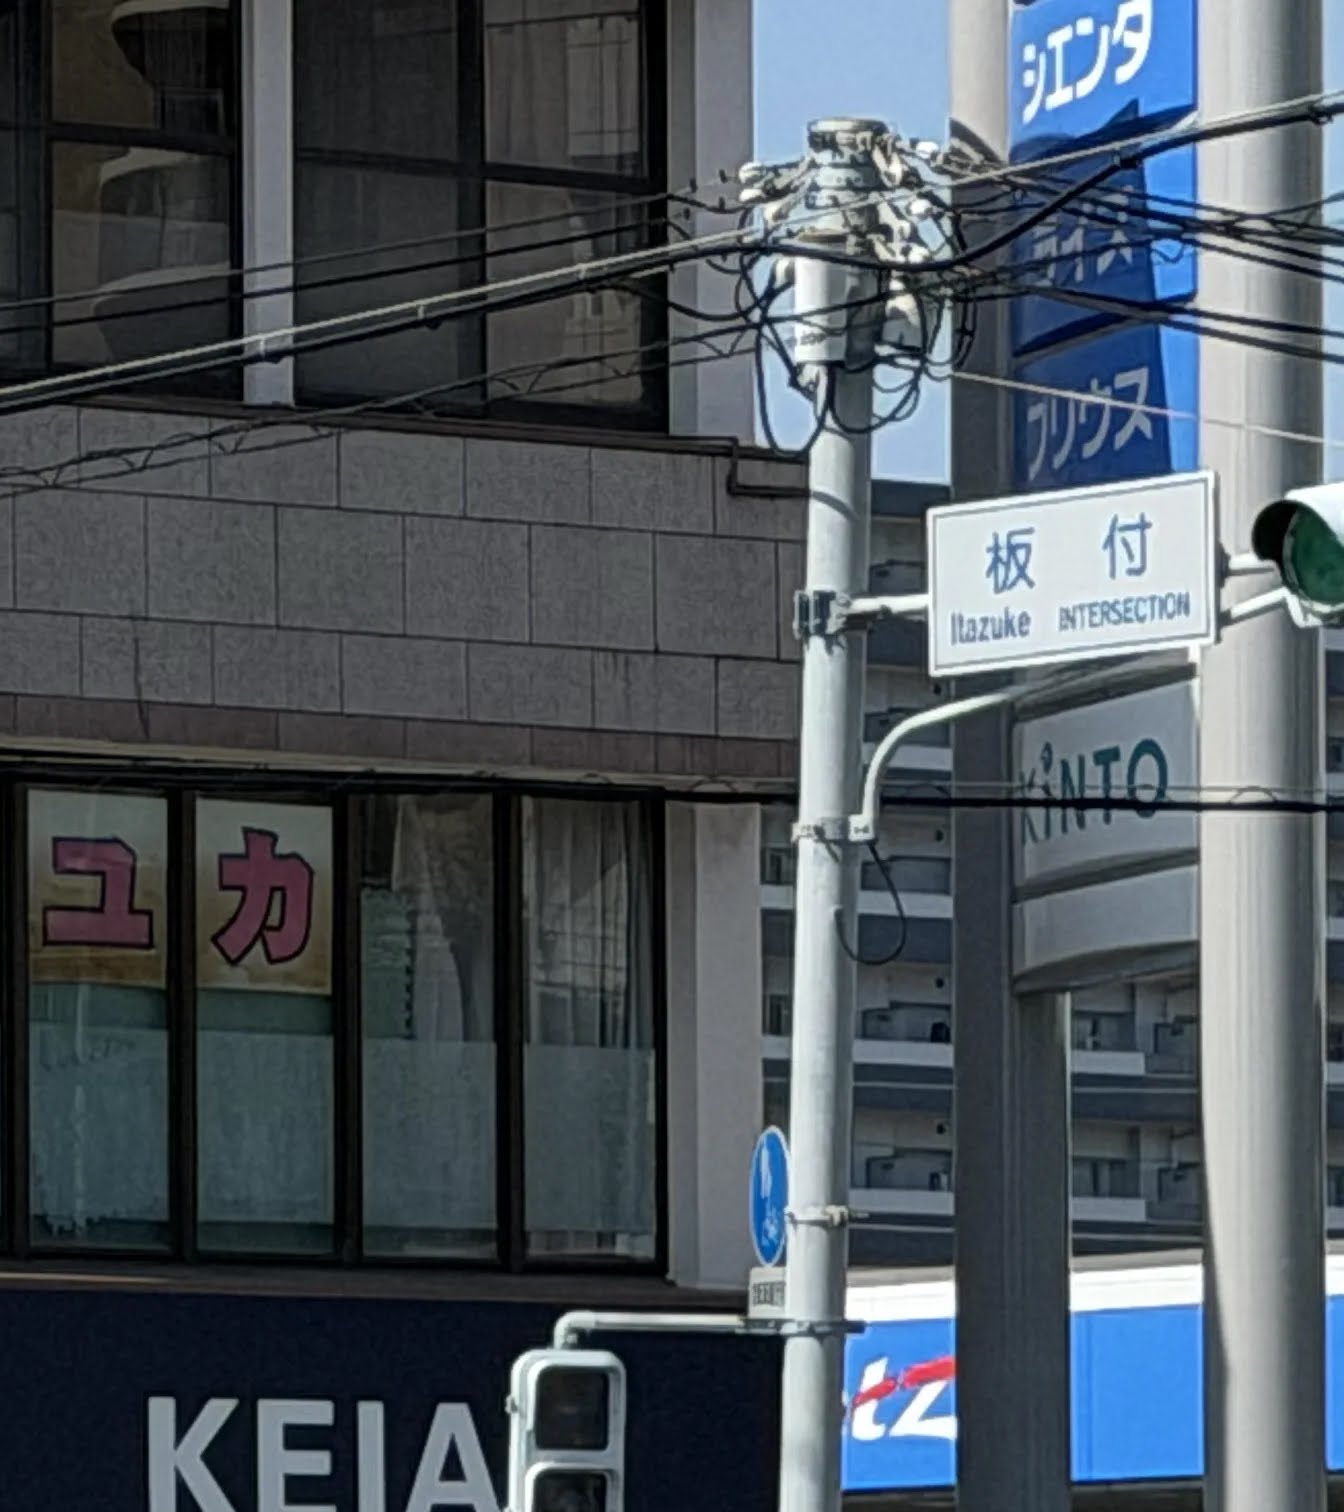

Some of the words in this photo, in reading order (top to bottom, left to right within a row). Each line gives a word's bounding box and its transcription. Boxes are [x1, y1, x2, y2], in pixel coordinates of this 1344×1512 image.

[1022, 0, 1153, 125] シエンタ
[985, 512, 1153, 595] 板付
[950, 606, 1032, 647] Itazuke
[1058, 591, 1191, 633] INTERSECTION
[42, 827, 314, 966] ユカ
[844, 1355, 957, 1441] tz
